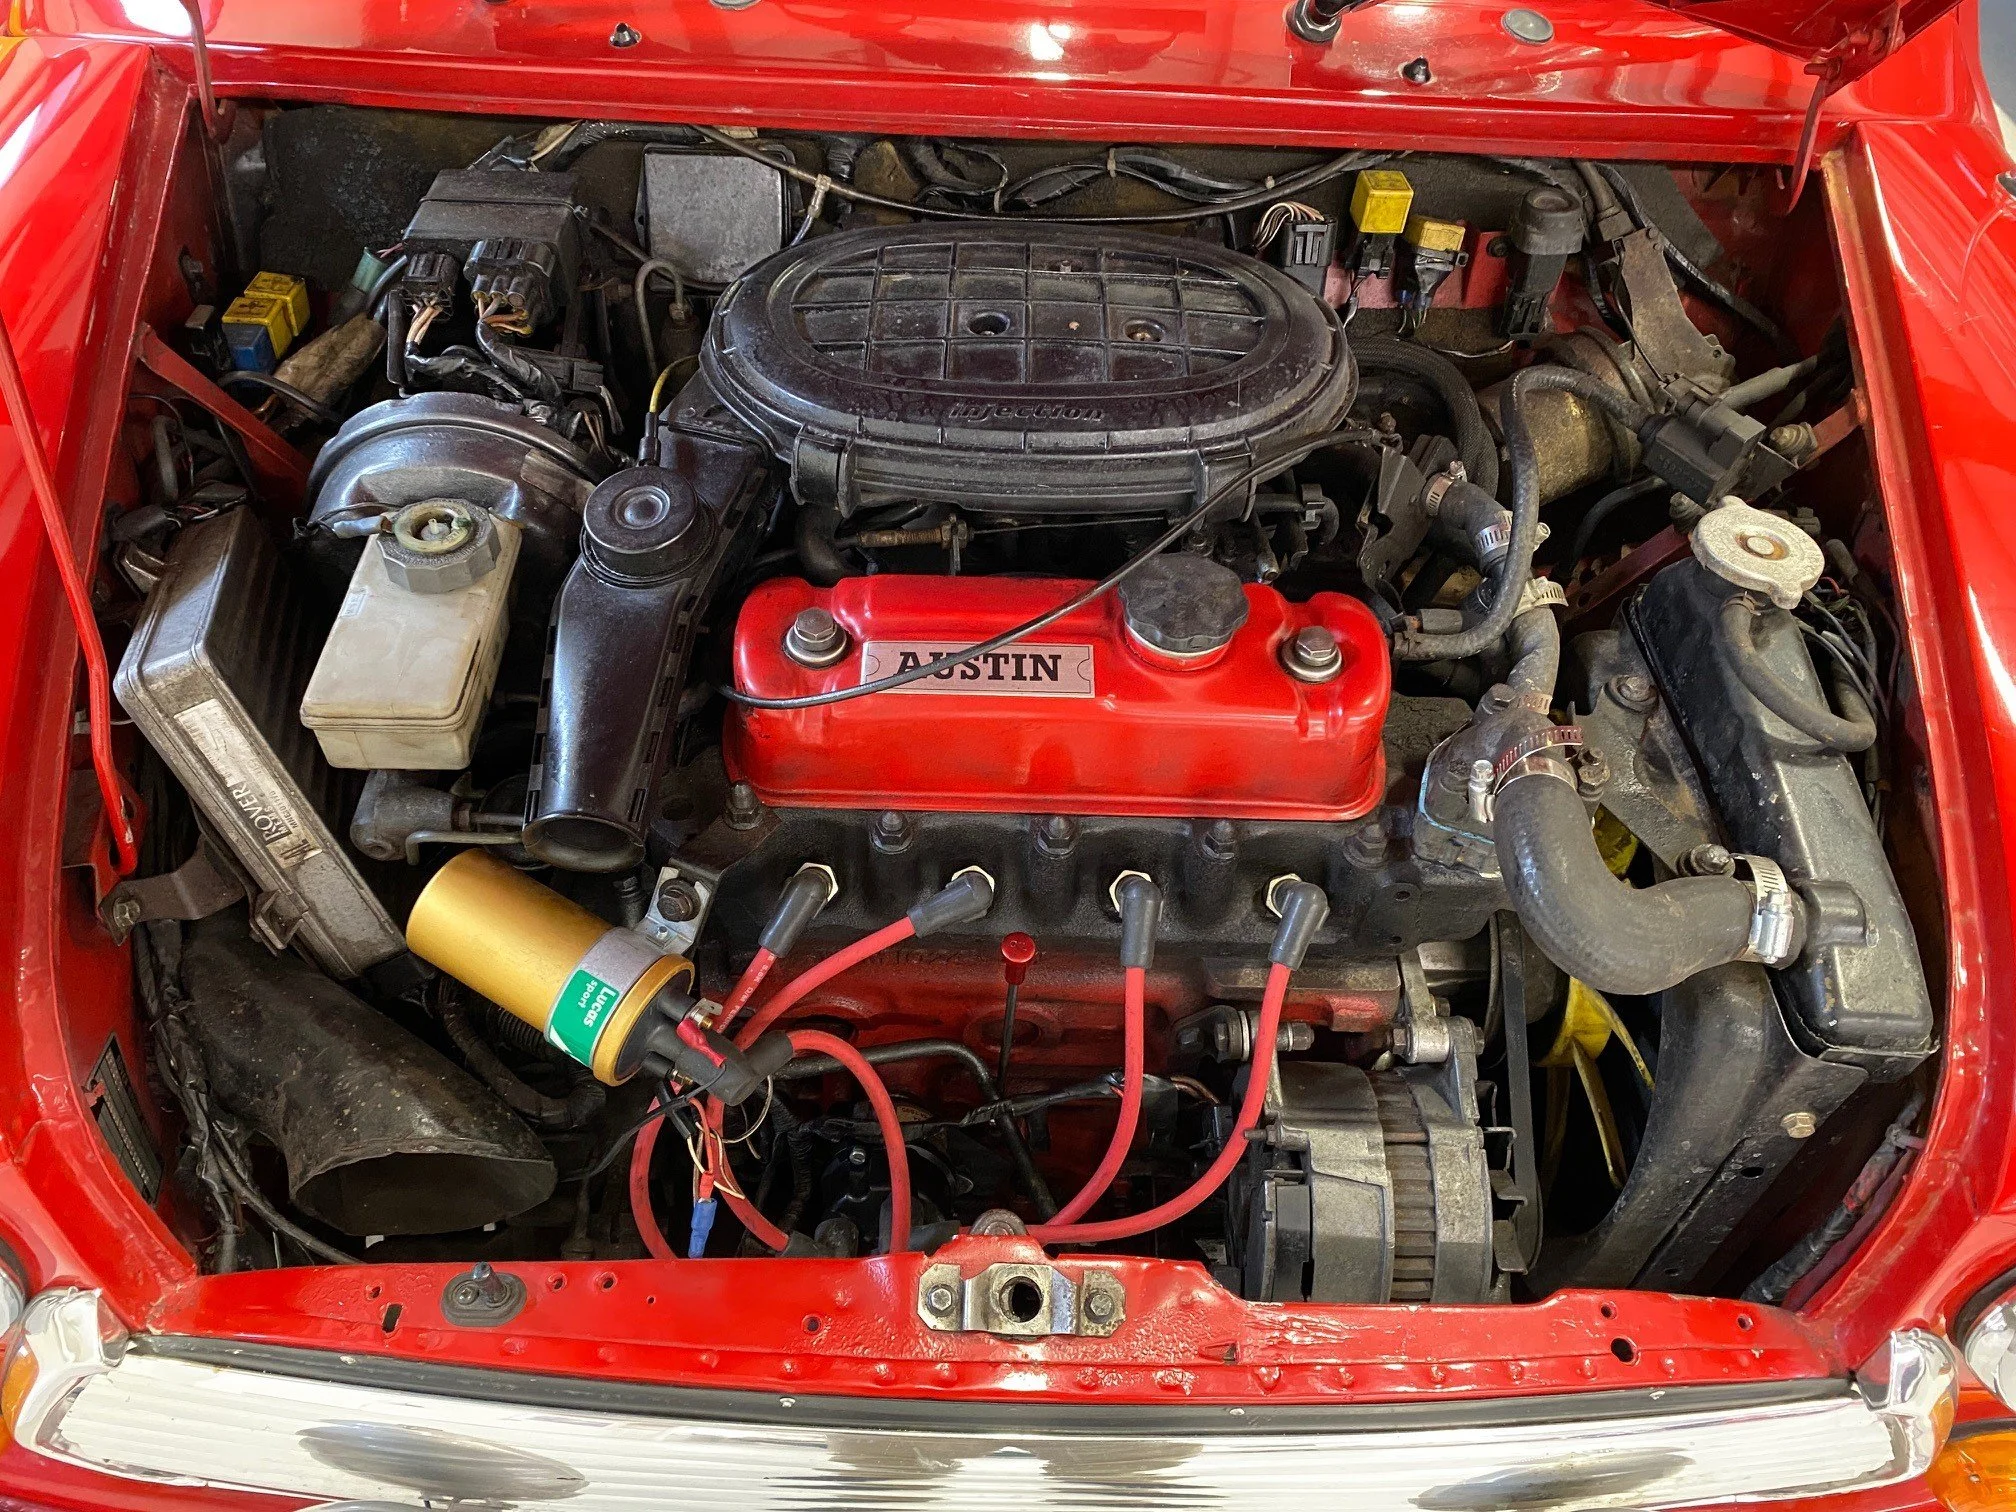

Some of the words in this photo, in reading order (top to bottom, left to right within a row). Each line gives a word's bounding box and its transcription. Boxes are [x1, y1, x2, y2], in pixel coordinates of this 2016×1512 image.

[949, 402, 1105, 423] injection
[893, 651, 1062, 682] AUSTIN
[232, 783, 282, 842] ROVER
[577, 979, 598, 1009] sport
[583, 986, 617, 1028] Lucas
